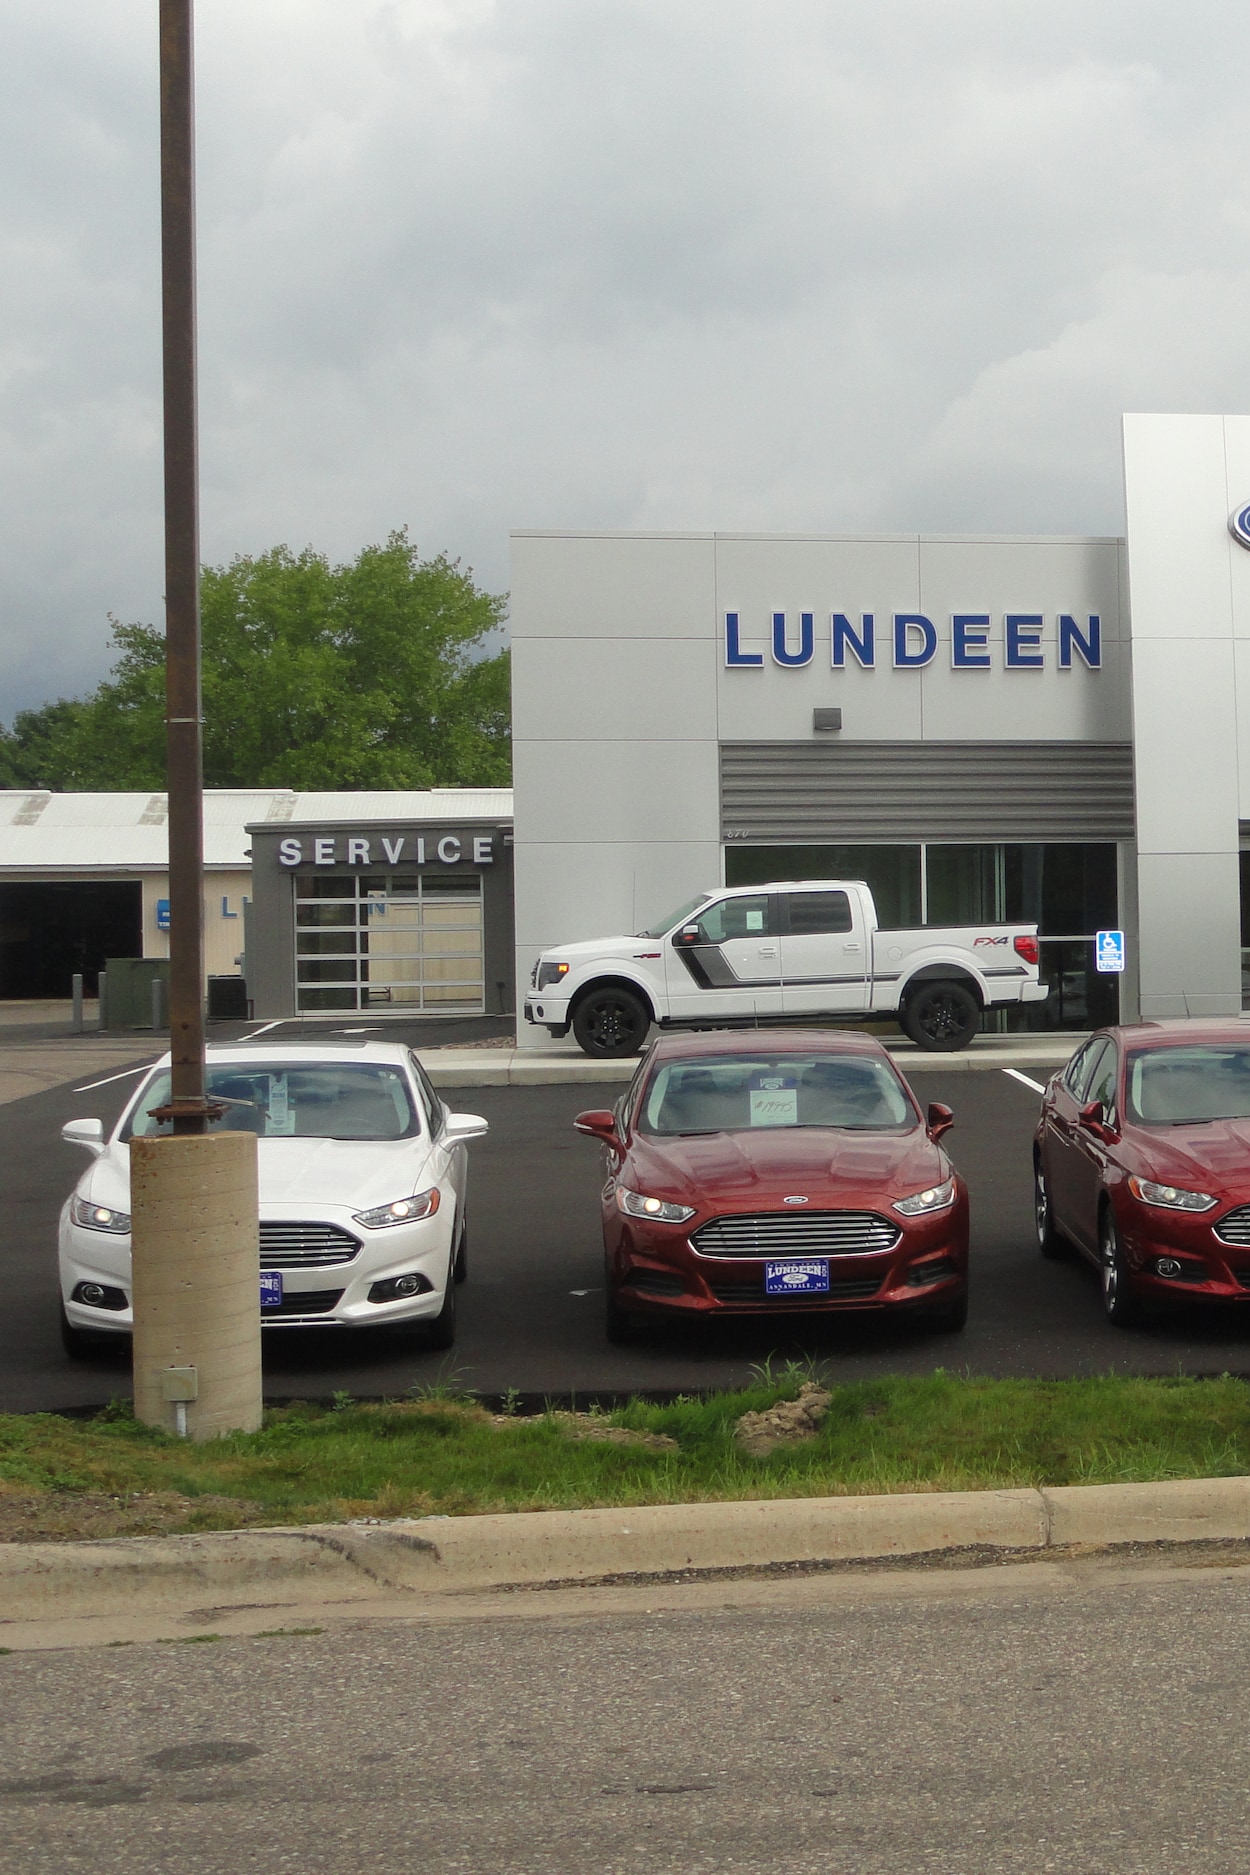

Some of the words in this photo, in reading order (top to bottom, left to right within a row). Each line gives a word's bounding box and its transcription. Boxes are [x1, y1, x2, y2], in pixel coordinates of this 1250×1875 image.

[724, 611, 1102, 669] LUNDEEN
[279, 836, 493, 866] SERVICE
[973, 936, 1009, 946] FX4
[768, 1265, 822, 1279] LUNDEEN
